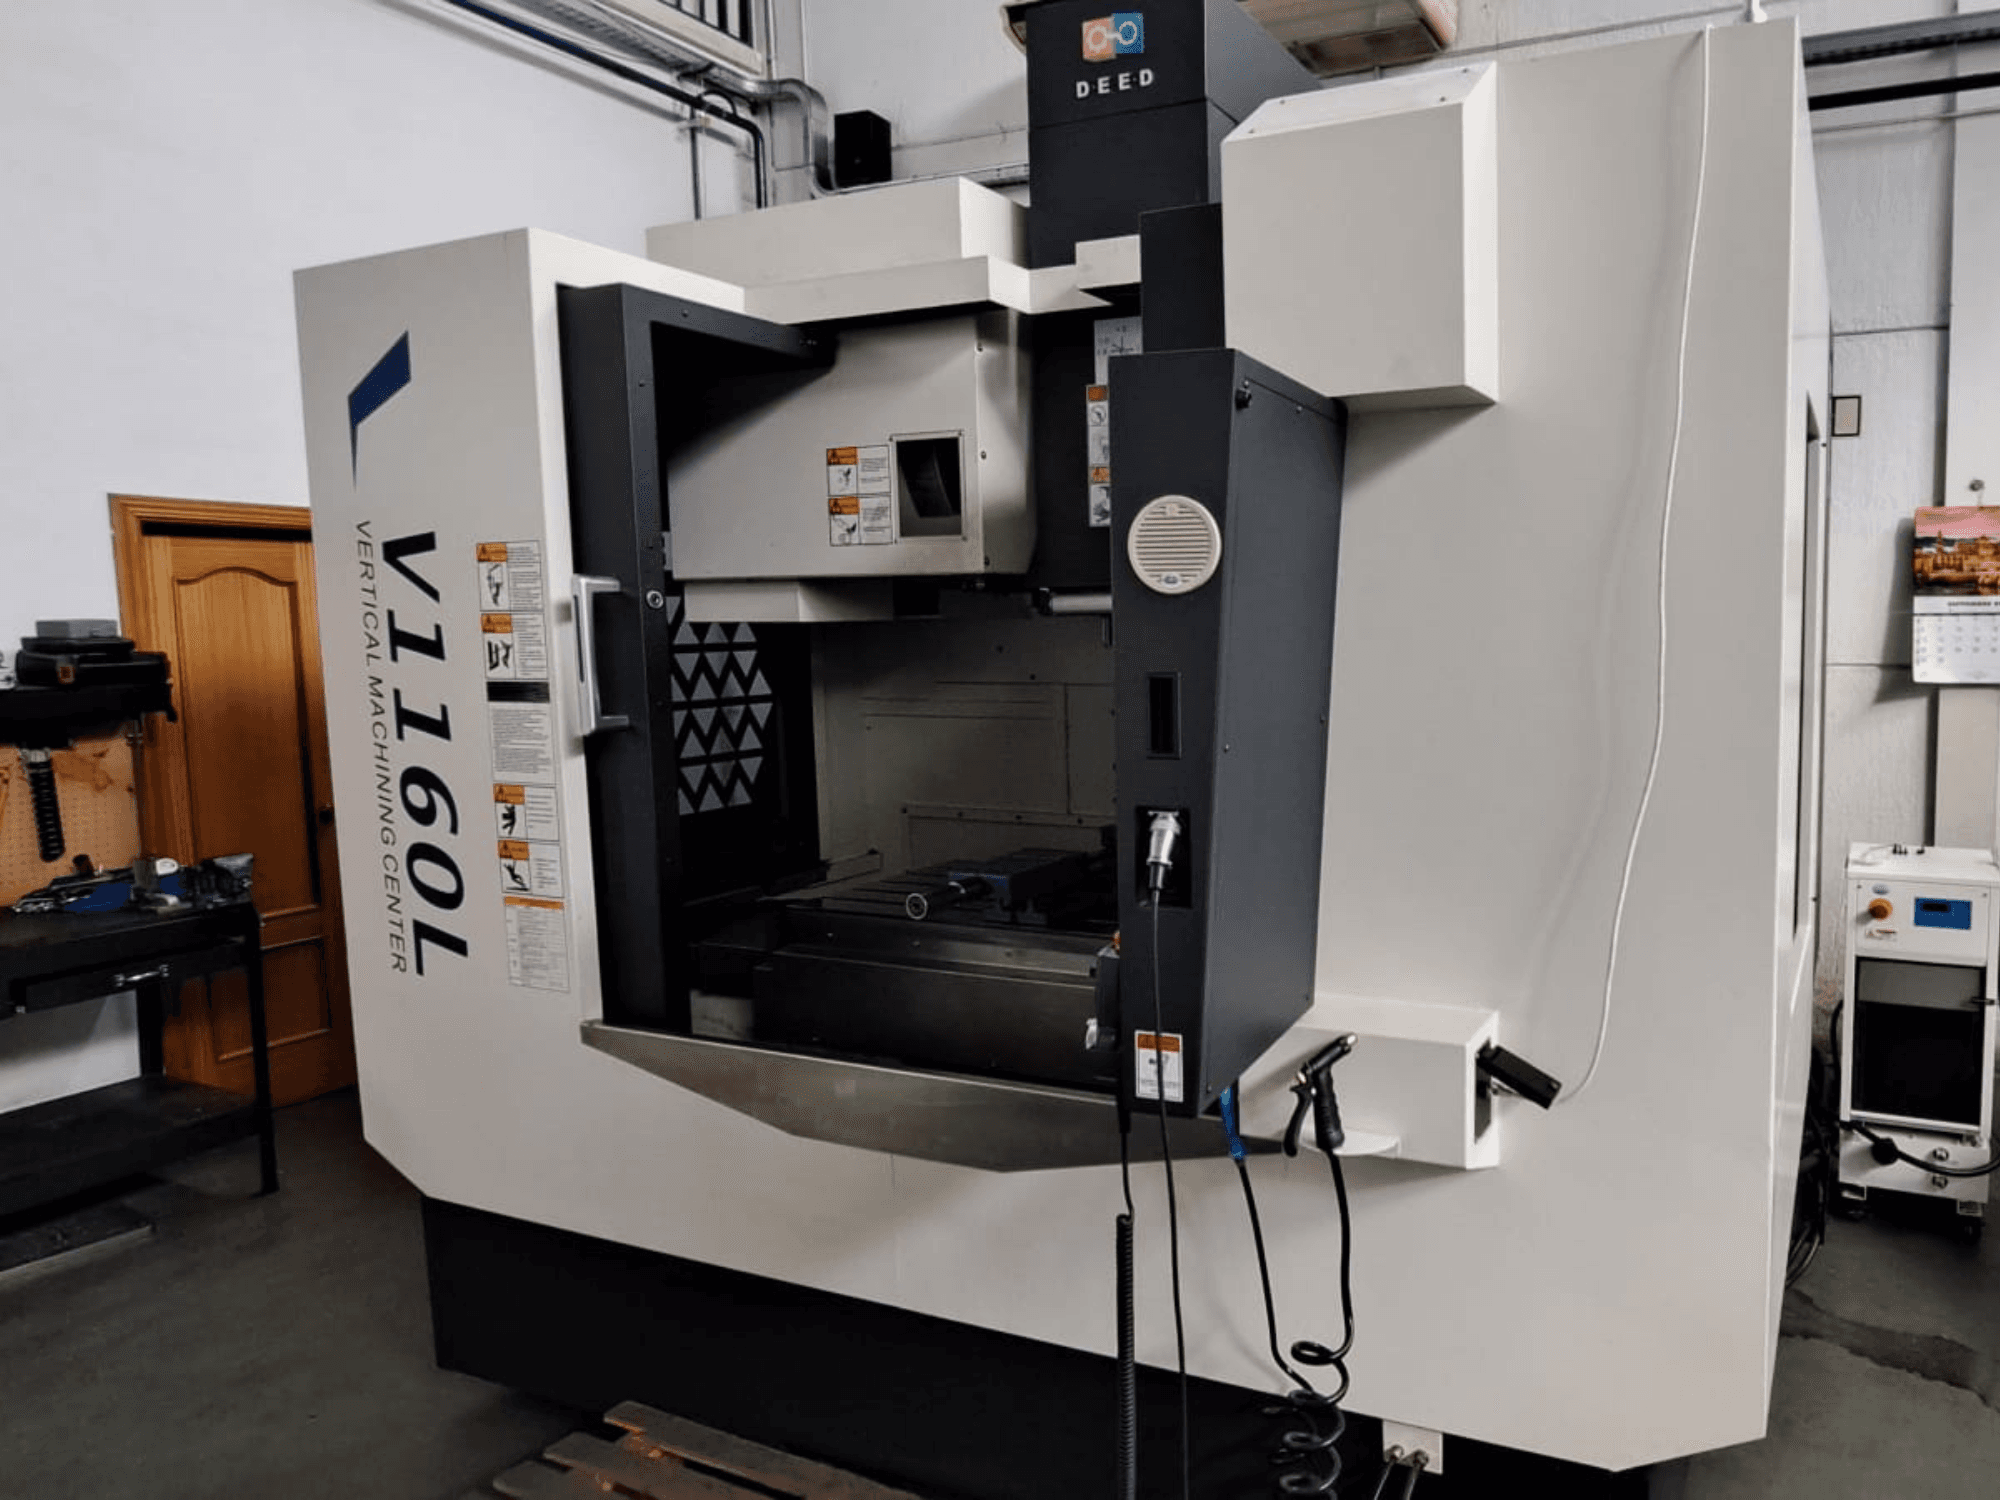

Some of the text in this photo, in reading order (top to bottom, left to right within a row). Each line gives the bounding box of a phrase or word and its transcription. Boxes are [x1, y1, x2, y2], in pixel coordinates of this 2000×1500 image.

[355, 520, 408, 973] VERTICAL MACHINING CENTER
[380, 530, 469, 977] V1160L
